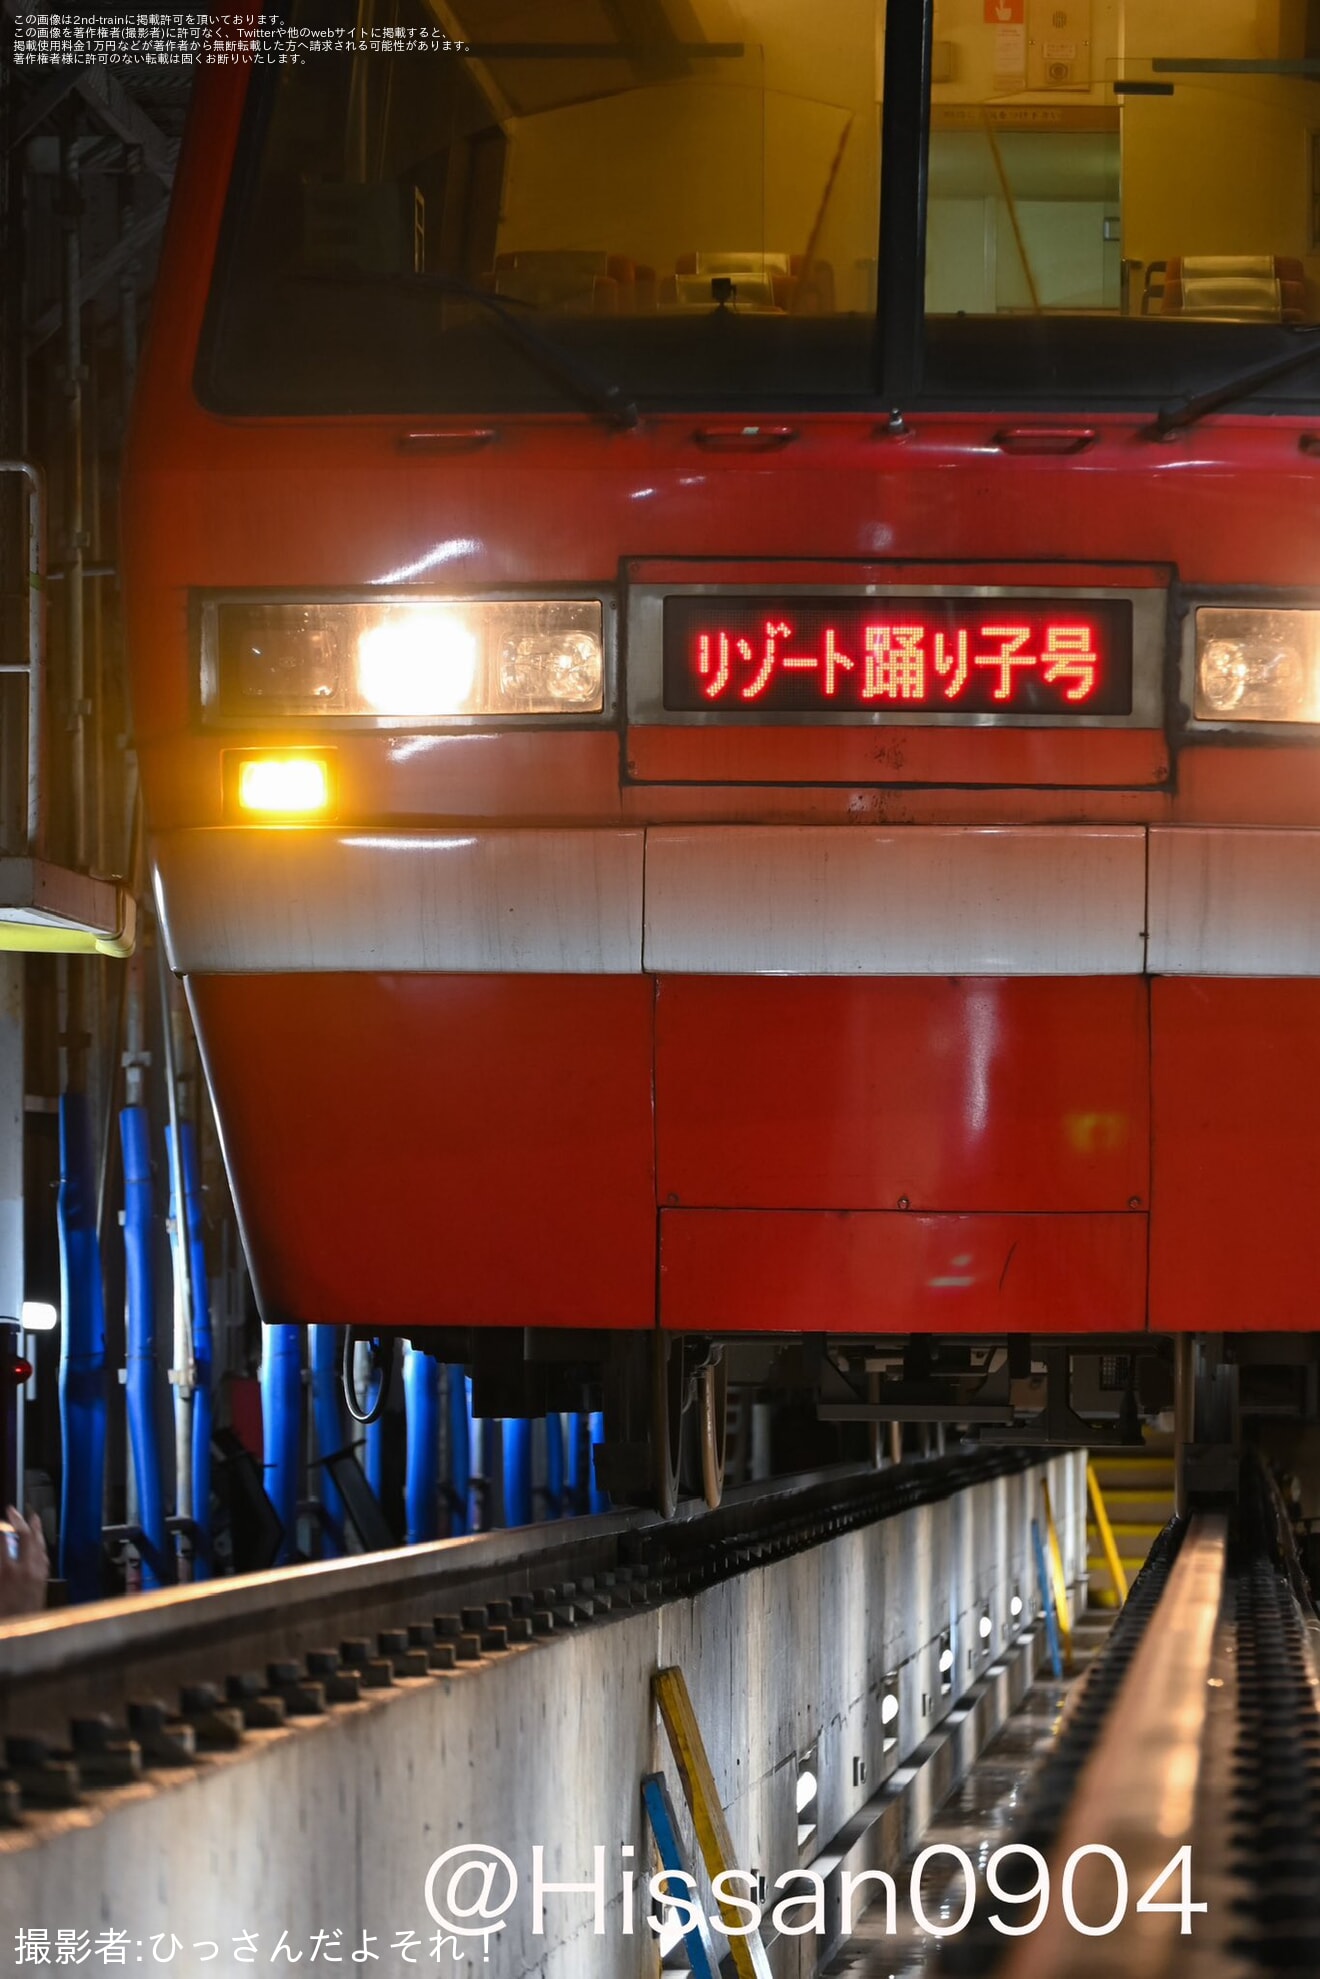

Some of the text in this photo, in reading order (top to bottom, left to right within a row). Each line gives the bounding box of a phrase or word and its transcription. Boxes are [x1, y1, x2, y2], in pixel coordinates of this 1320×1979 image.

[699, 621, 1096, 700] リゾート踊り子号
